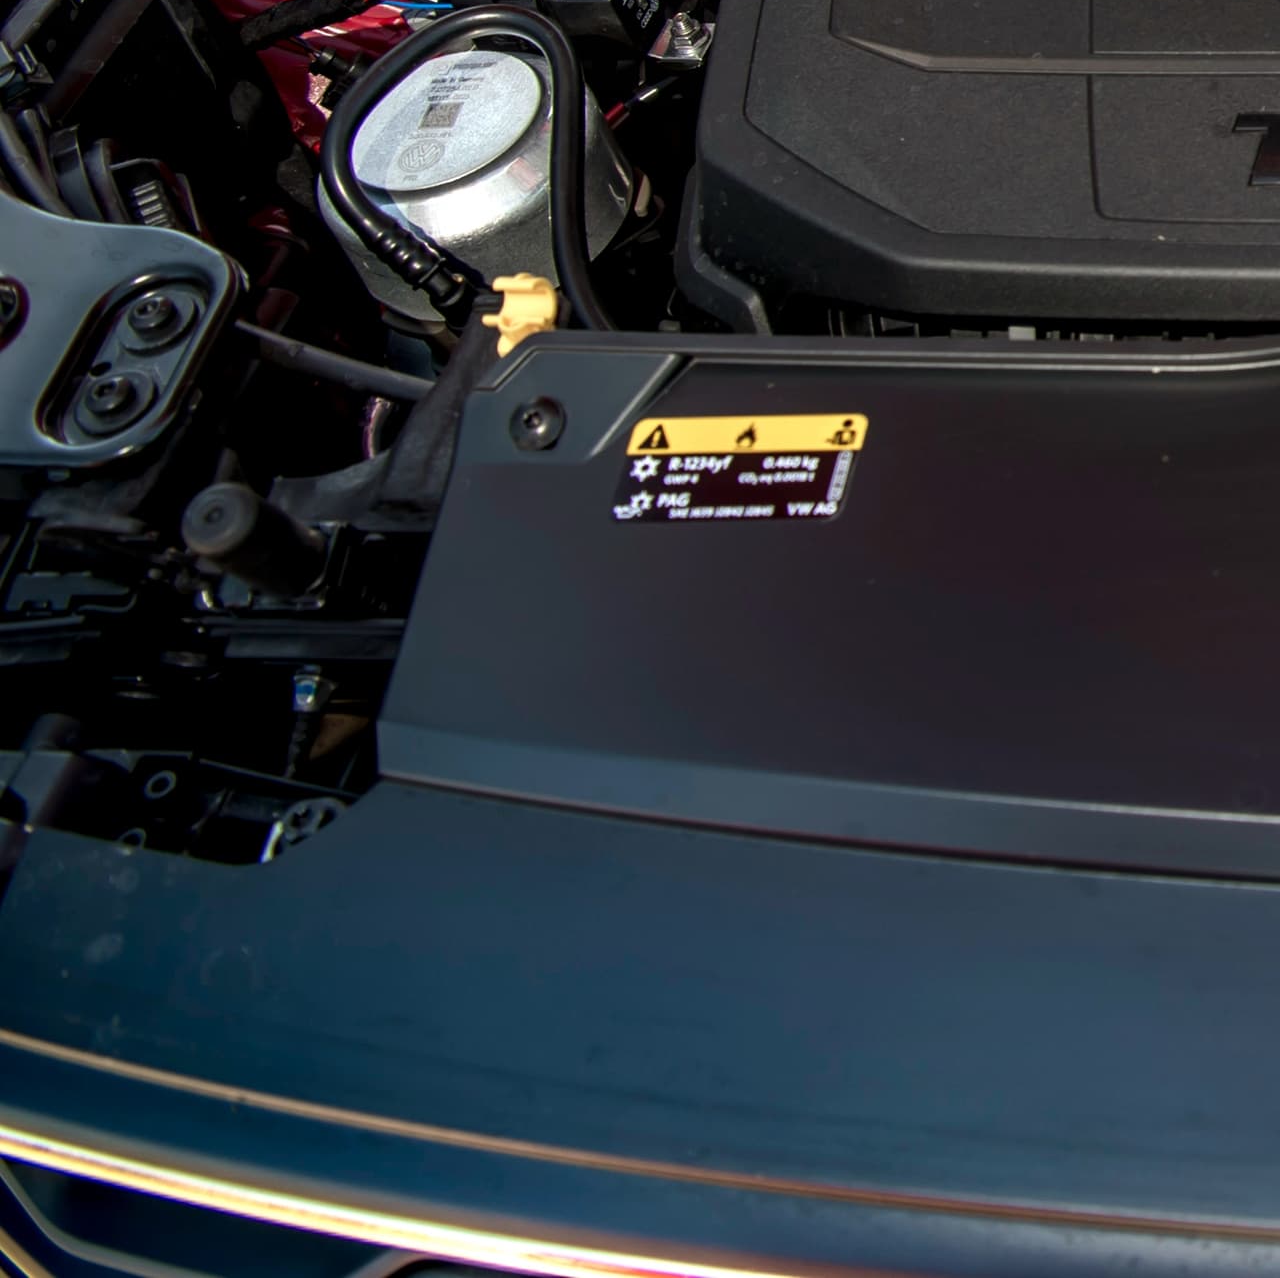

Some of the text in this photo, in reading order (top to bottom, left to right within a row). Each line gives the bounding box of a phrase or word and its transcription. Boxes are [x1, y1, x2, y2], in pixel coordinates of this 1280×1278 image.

[656, 492, 691, 508] PAG
[787, 502, 814, 516] VW
[813, 500, 838, 515] AG
